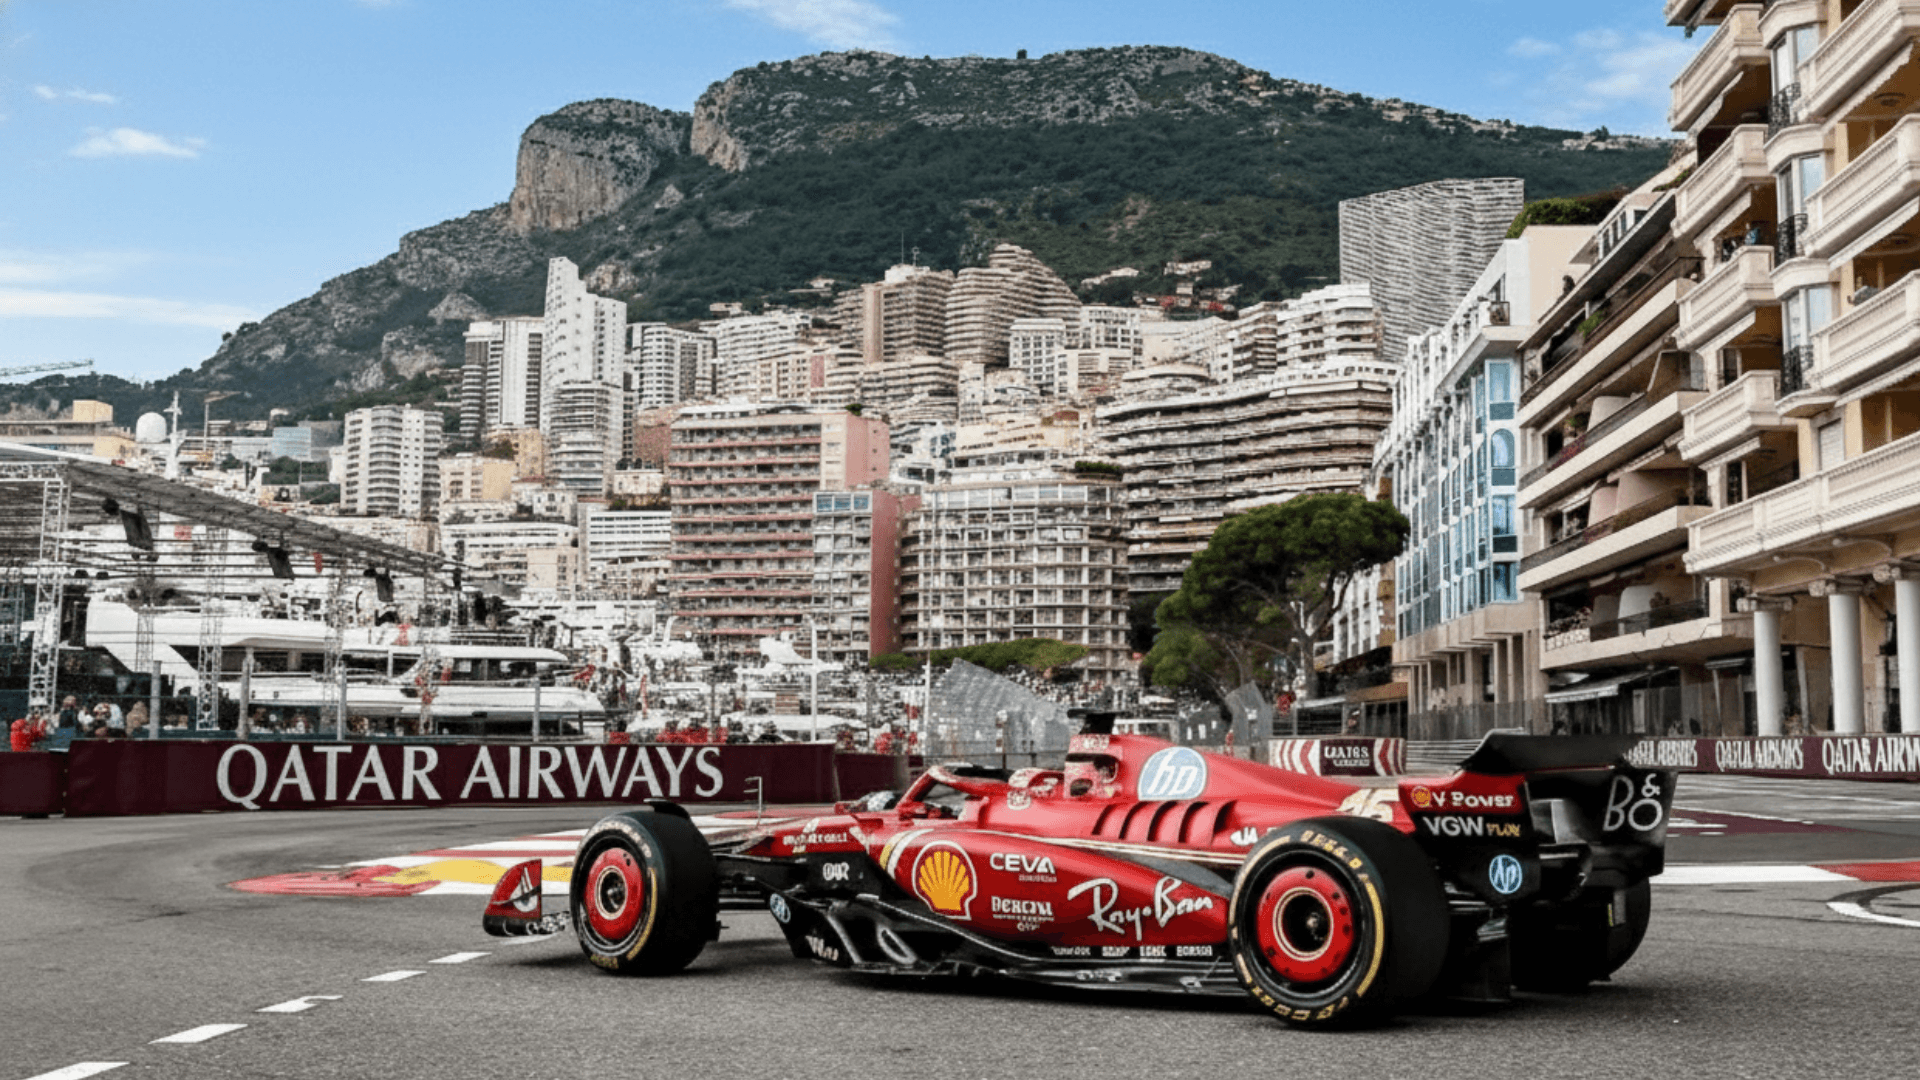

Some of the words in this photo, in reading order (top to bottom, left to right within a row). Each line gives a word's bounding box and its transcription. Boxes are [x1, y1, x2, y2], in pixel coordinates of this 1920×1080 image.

[1147, 749, 1198, 796] hp
[1822, 738, 1872, 775] QATAR
[216, 744, 442, 810] QATAR
[459, 745, 724, 799] AIRWAYS
[1423, 816, 1484, 836] VGW
[990, 853, 1056, 874] CEVA
